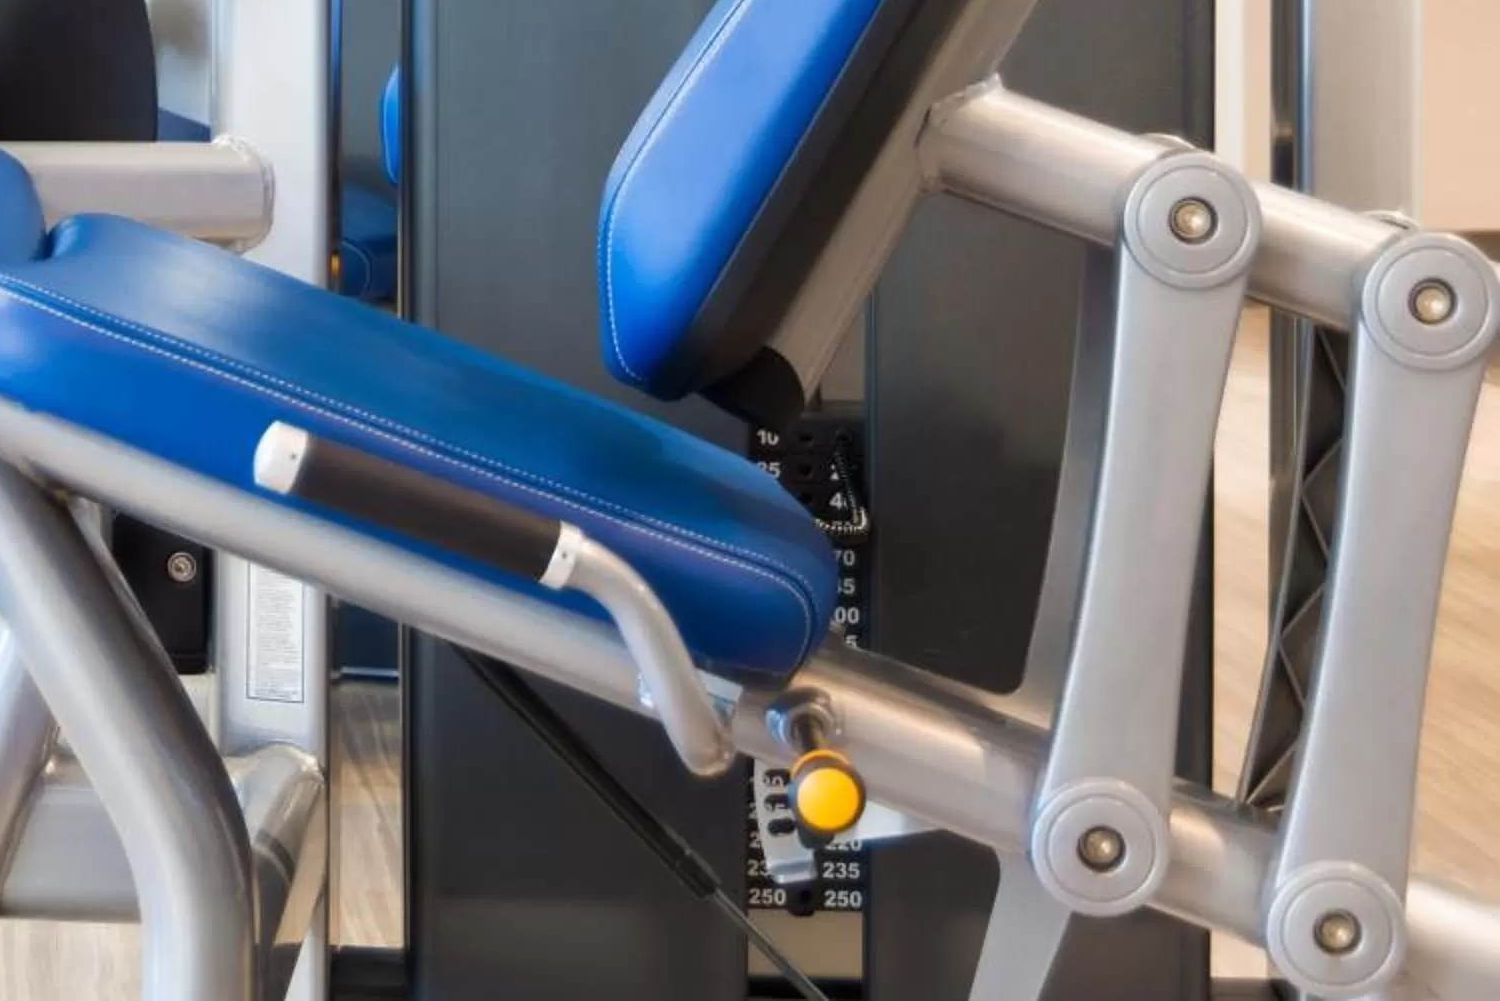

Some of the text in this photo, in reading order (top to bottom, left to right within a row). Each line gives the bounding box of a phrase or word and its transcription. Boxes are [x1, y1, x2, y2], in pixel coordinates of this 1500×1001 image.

[756, 429, 779, 446] 10
[822, 862, 860, 879] 235
[748, 888, 863, 908] 250 250
